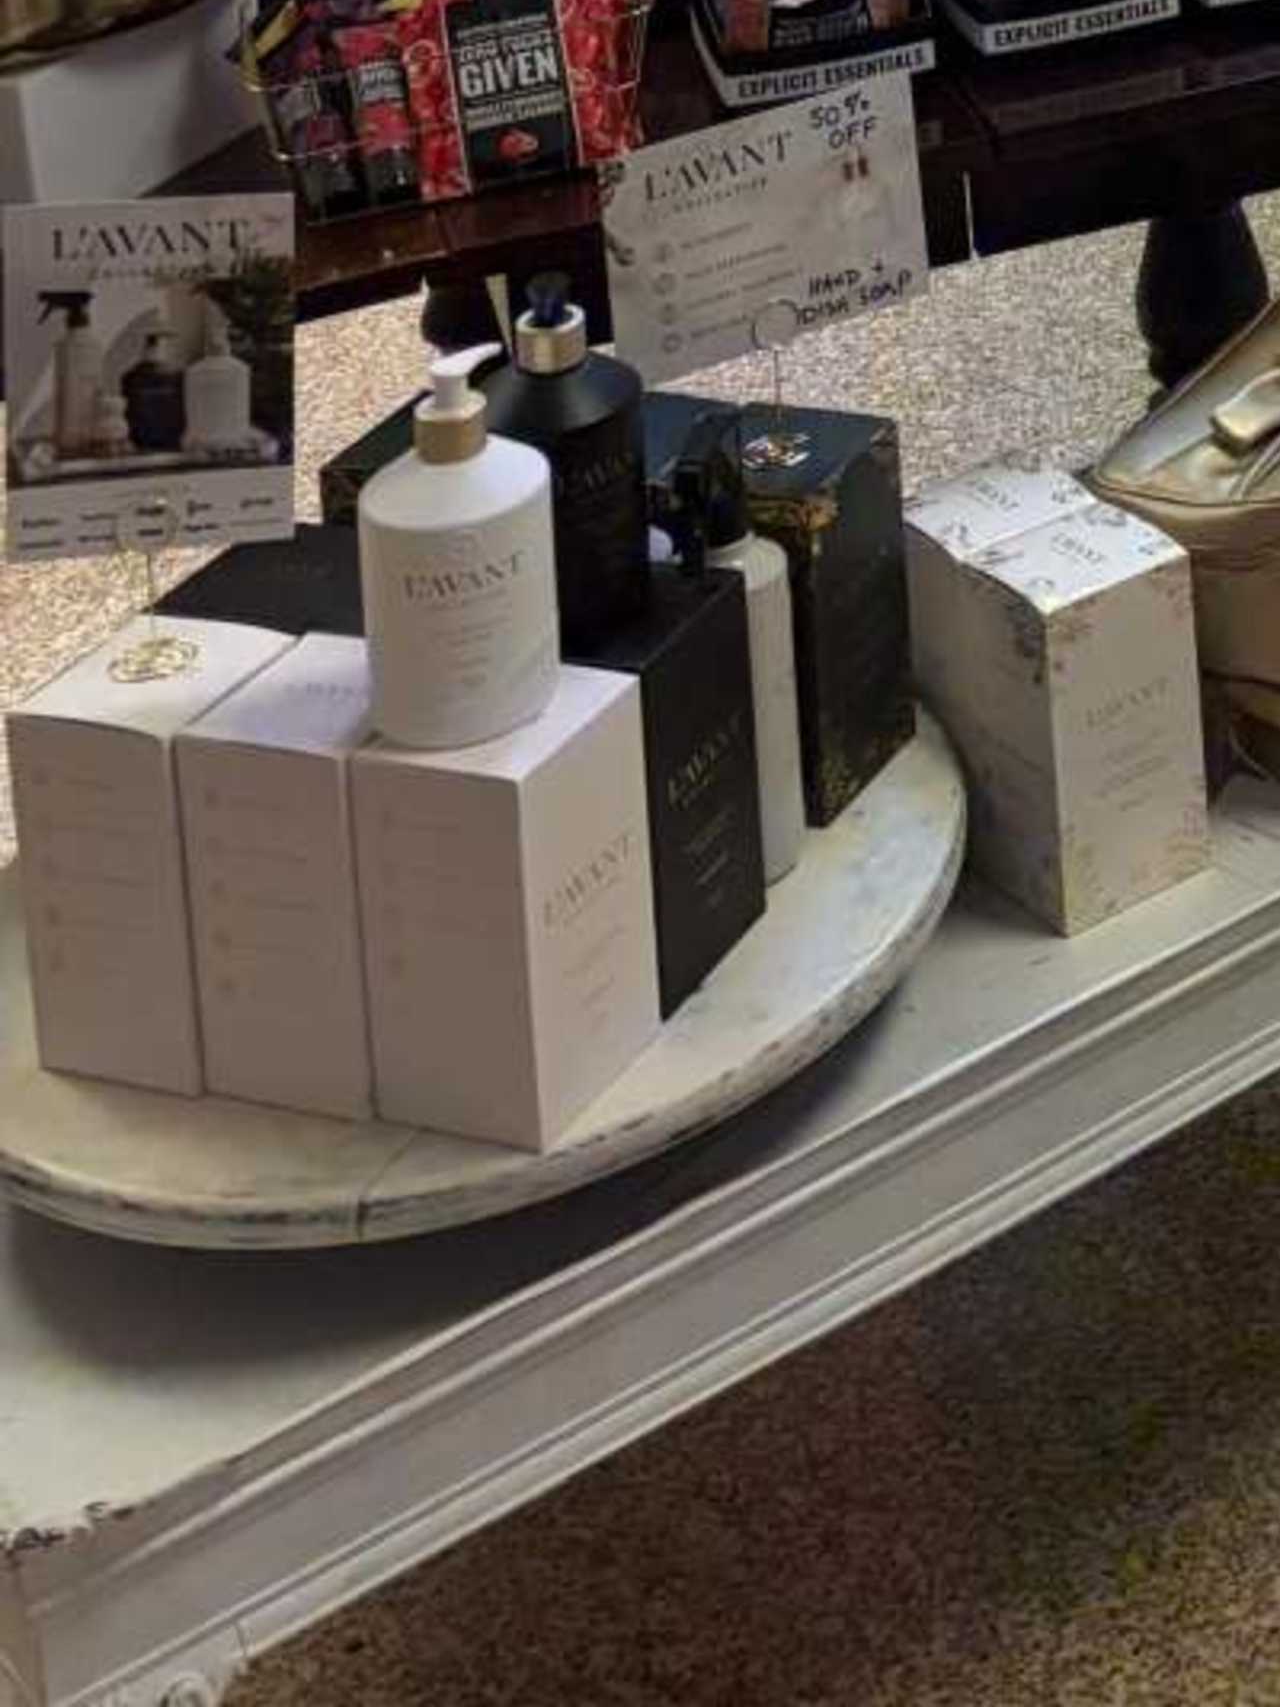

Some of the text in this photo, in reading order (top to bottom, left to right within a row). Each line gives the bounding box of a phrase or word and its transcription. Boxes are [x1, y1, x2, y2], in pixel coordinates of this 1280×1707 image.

[994, 19, 1070, 47] EXPLICIT
[459, 47, 560, 99] GIVEN
[738, 46, 925, 99] EXPLICIT ESSENTIALS
[828, 116, 876, 149] OFF
[645, 130, 791, 201] L'AVANT
[52, 219, 250, 261] L'AVANT
[808, 269, 861, 298] HAND
[858, 270, 912, 306] SOAP
[403, 549, 526, 601] L'AVANT
